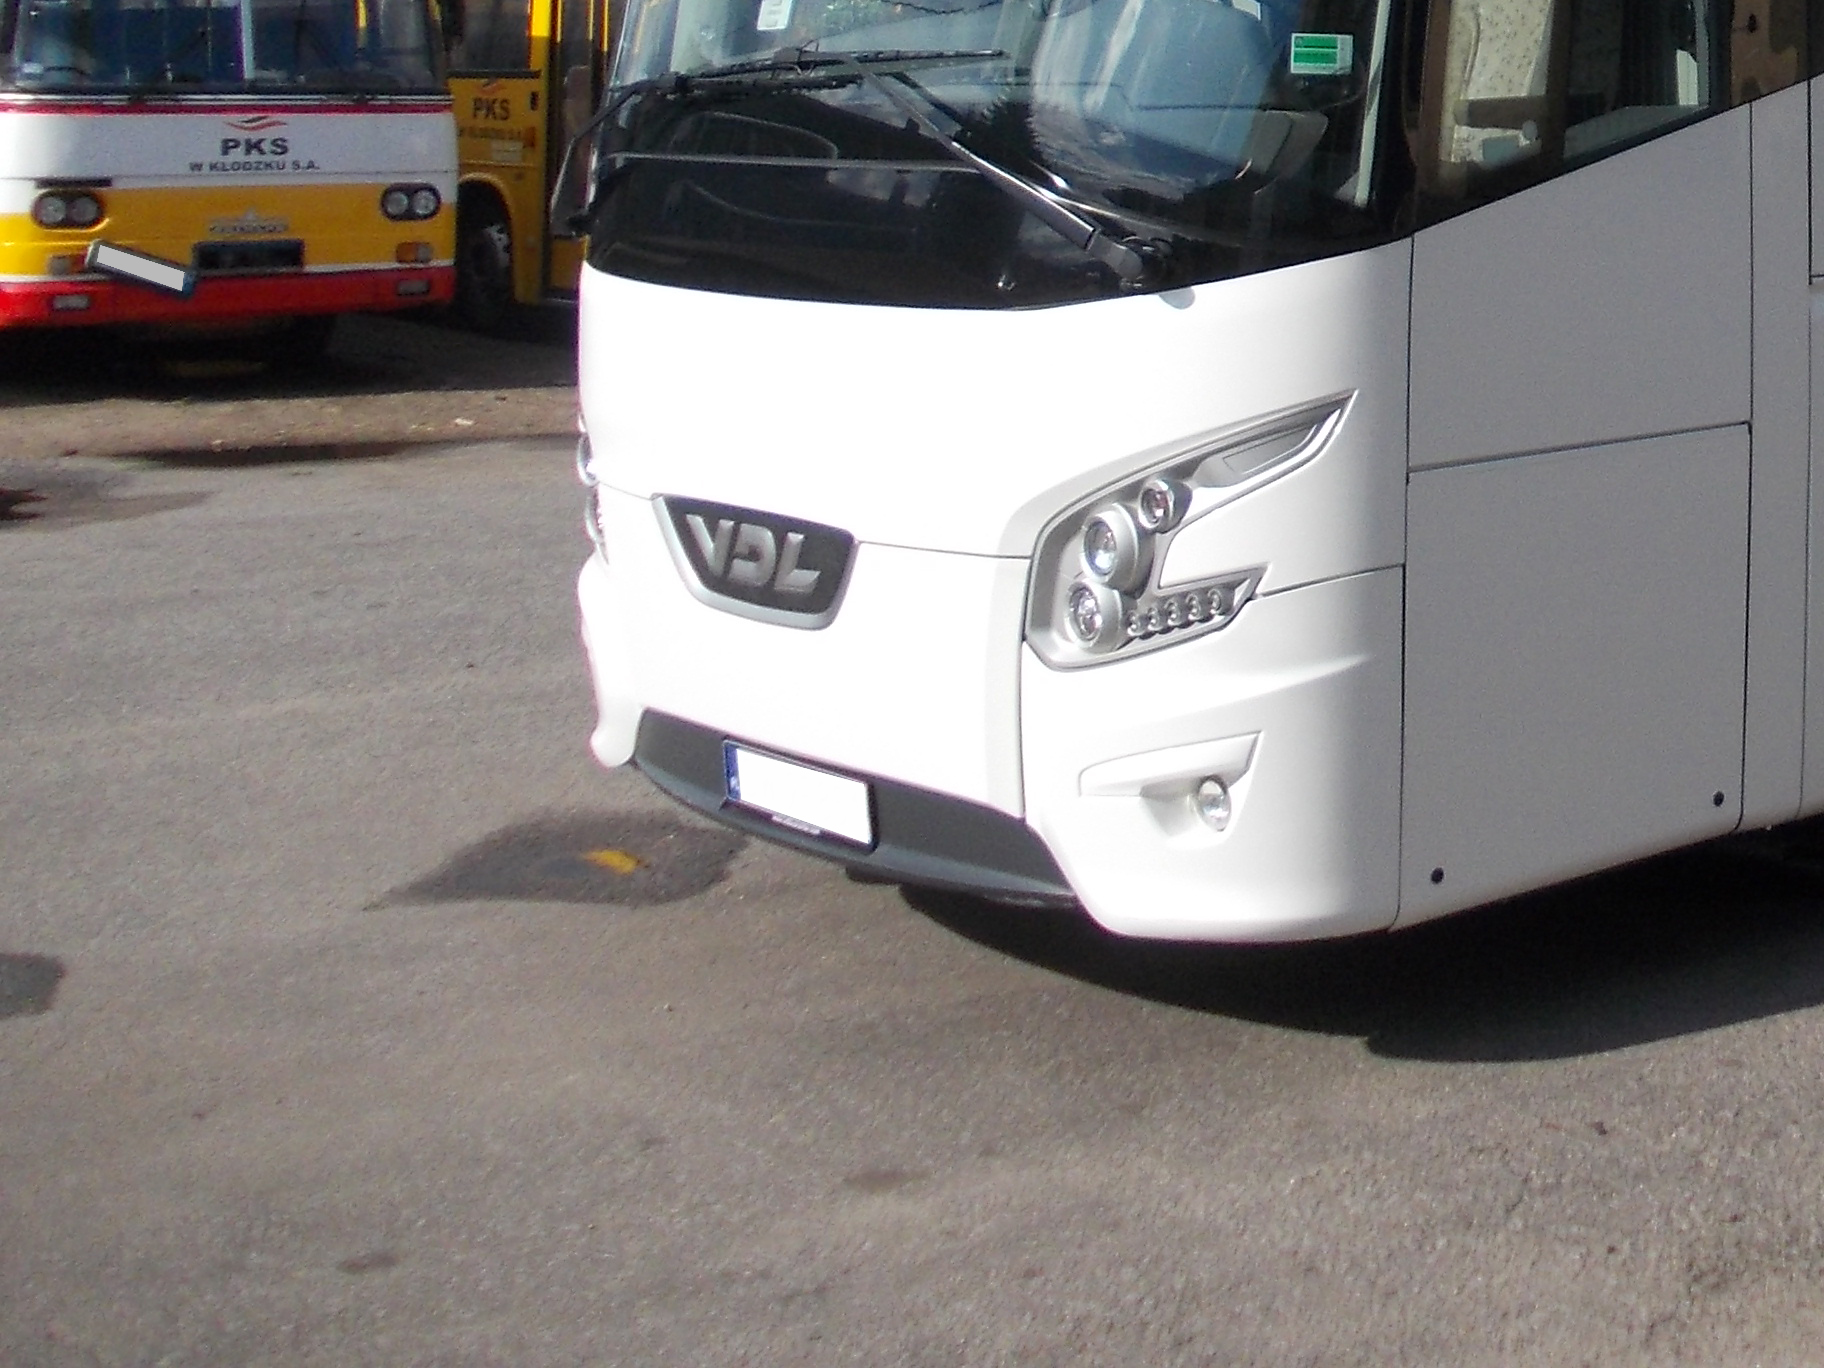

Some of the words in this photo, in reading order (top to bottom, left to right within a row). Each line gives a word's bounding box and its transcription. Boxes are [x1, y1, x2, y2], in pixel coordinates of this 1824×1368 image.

[472, 97, 511, 121] PKS
[221, 137, 289, 156] PKS
[189, 162, 203, 172] W
[292, 160, 320, 171] S.A.
[685, 514, 821, 593] VDL
